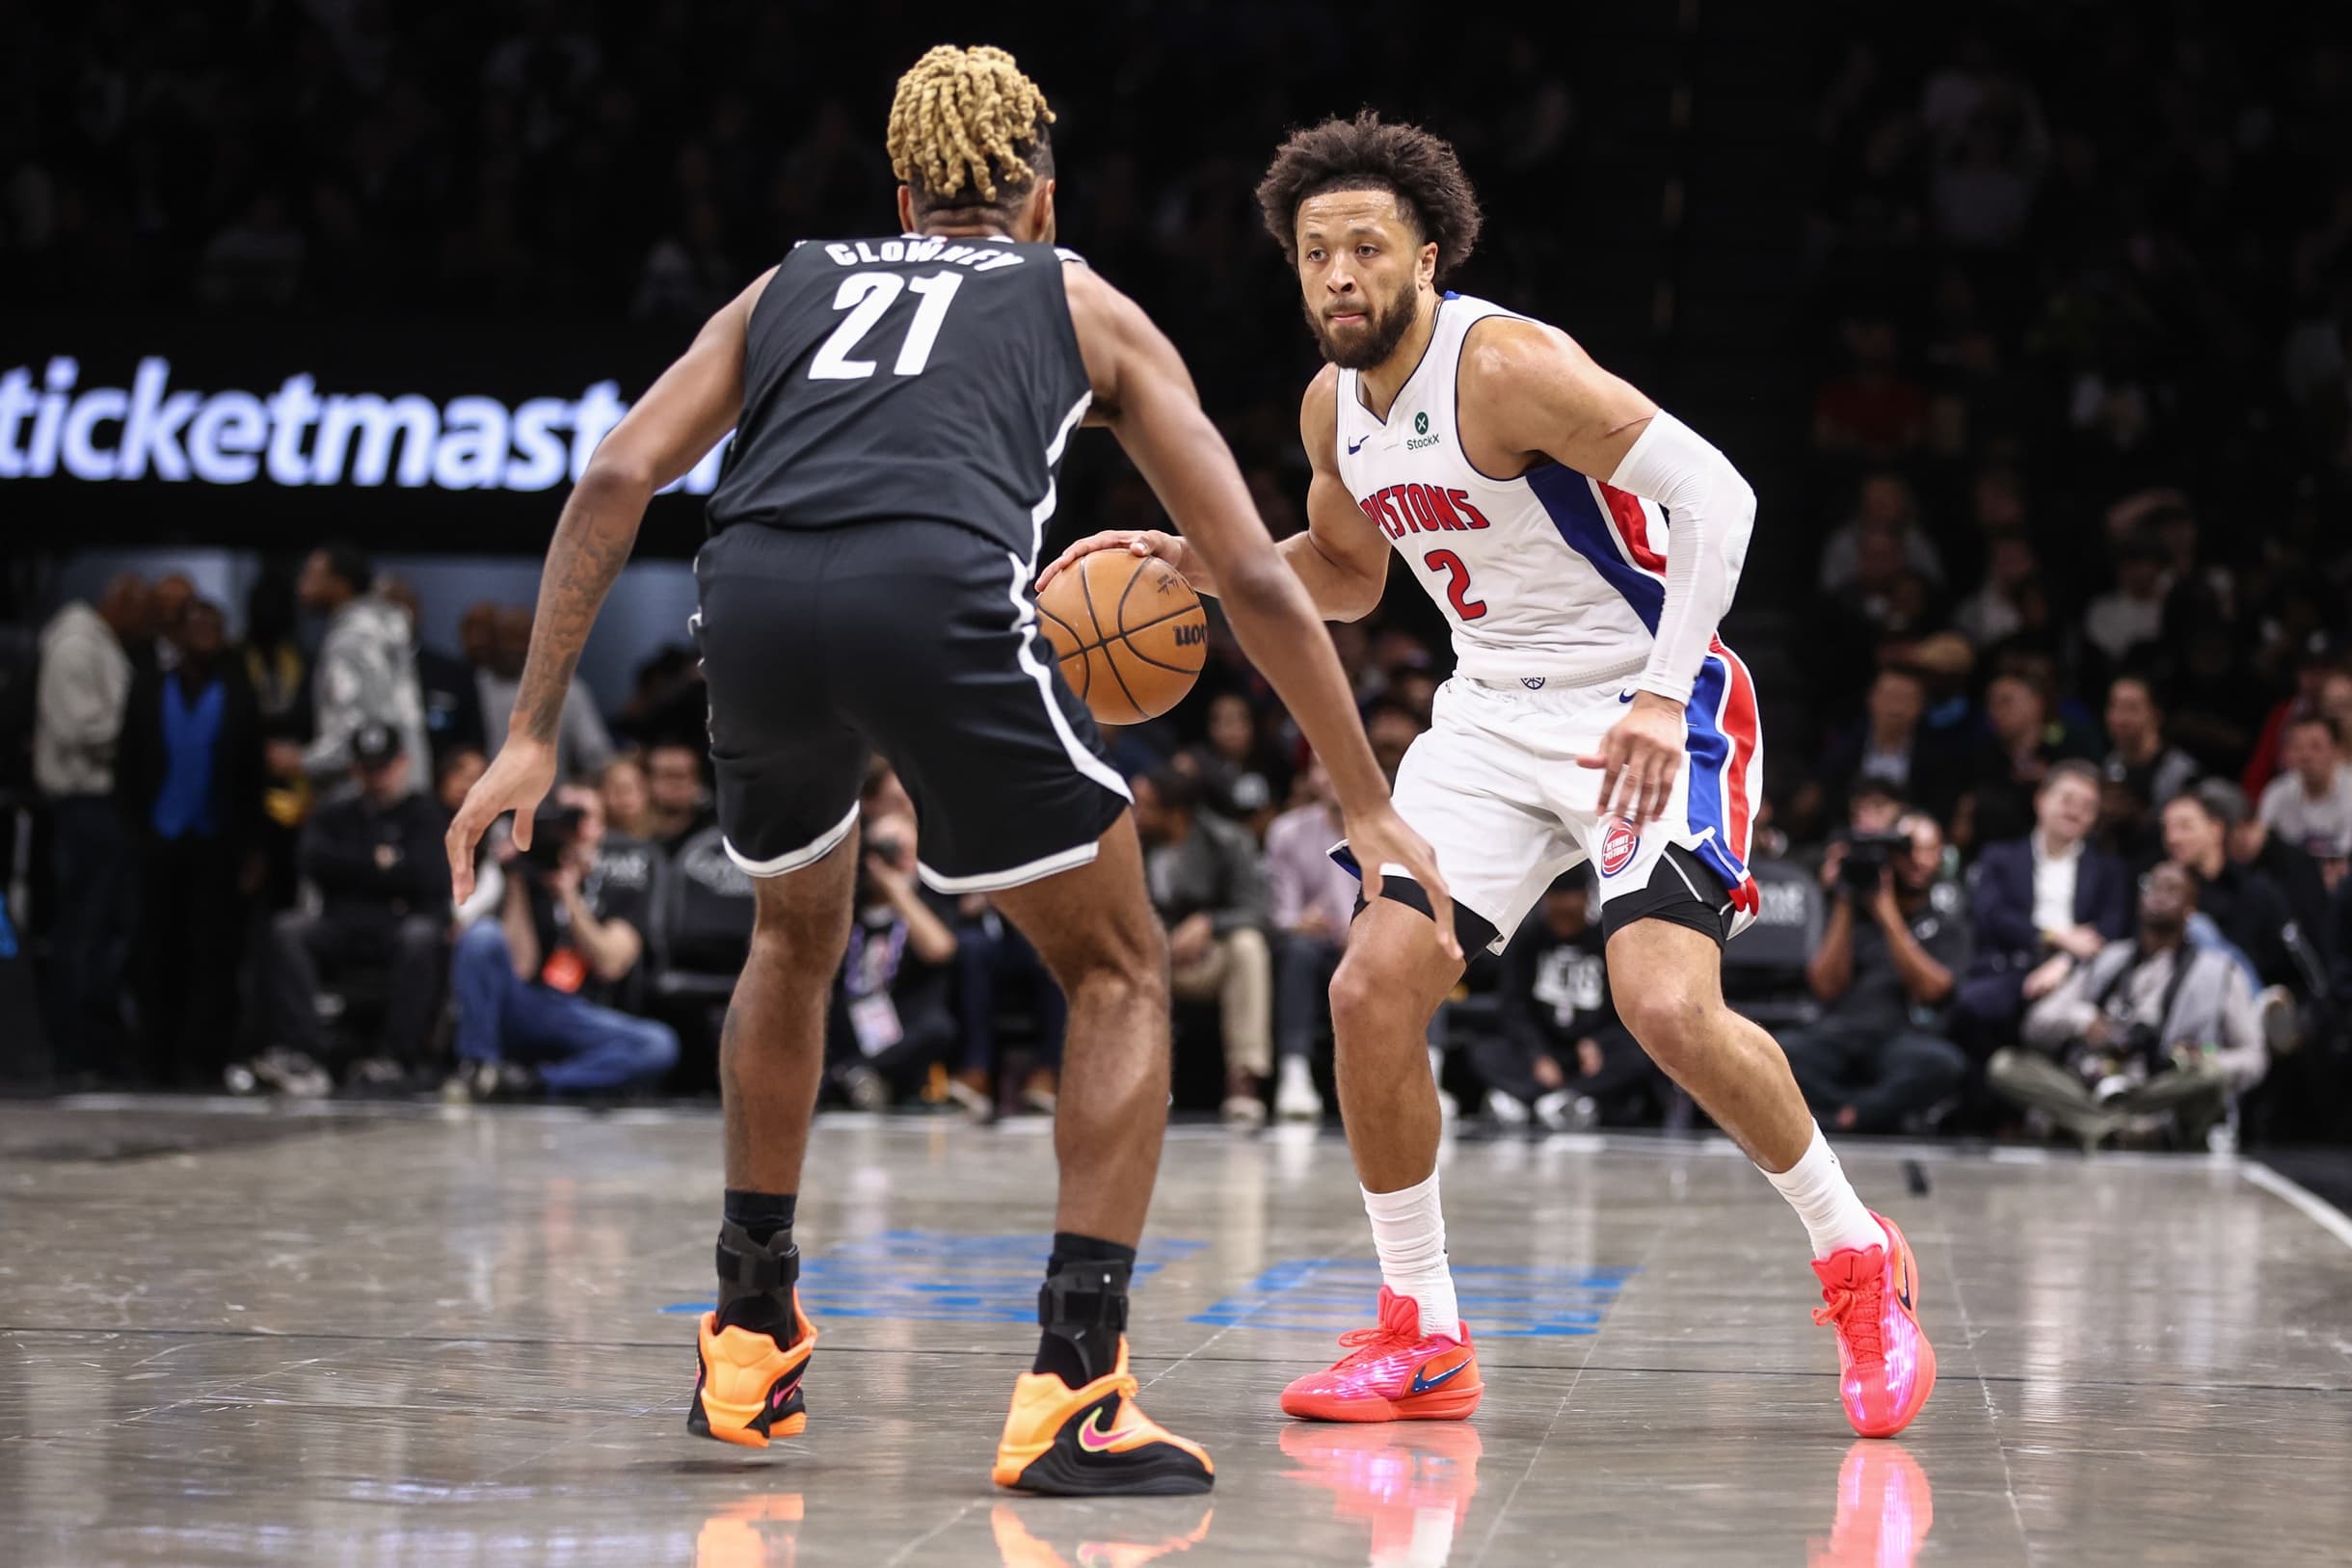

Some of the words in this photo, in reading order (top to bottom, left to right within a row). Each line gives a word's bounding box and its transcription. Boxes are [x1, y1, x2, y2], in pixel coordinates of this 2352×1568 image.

[808, 270, 963, 380] 21
[0, 356, 736, 496] ticketmast
[1406, 433, 1440, 450] StockX
[1424, 548, 1487, 622] 2
